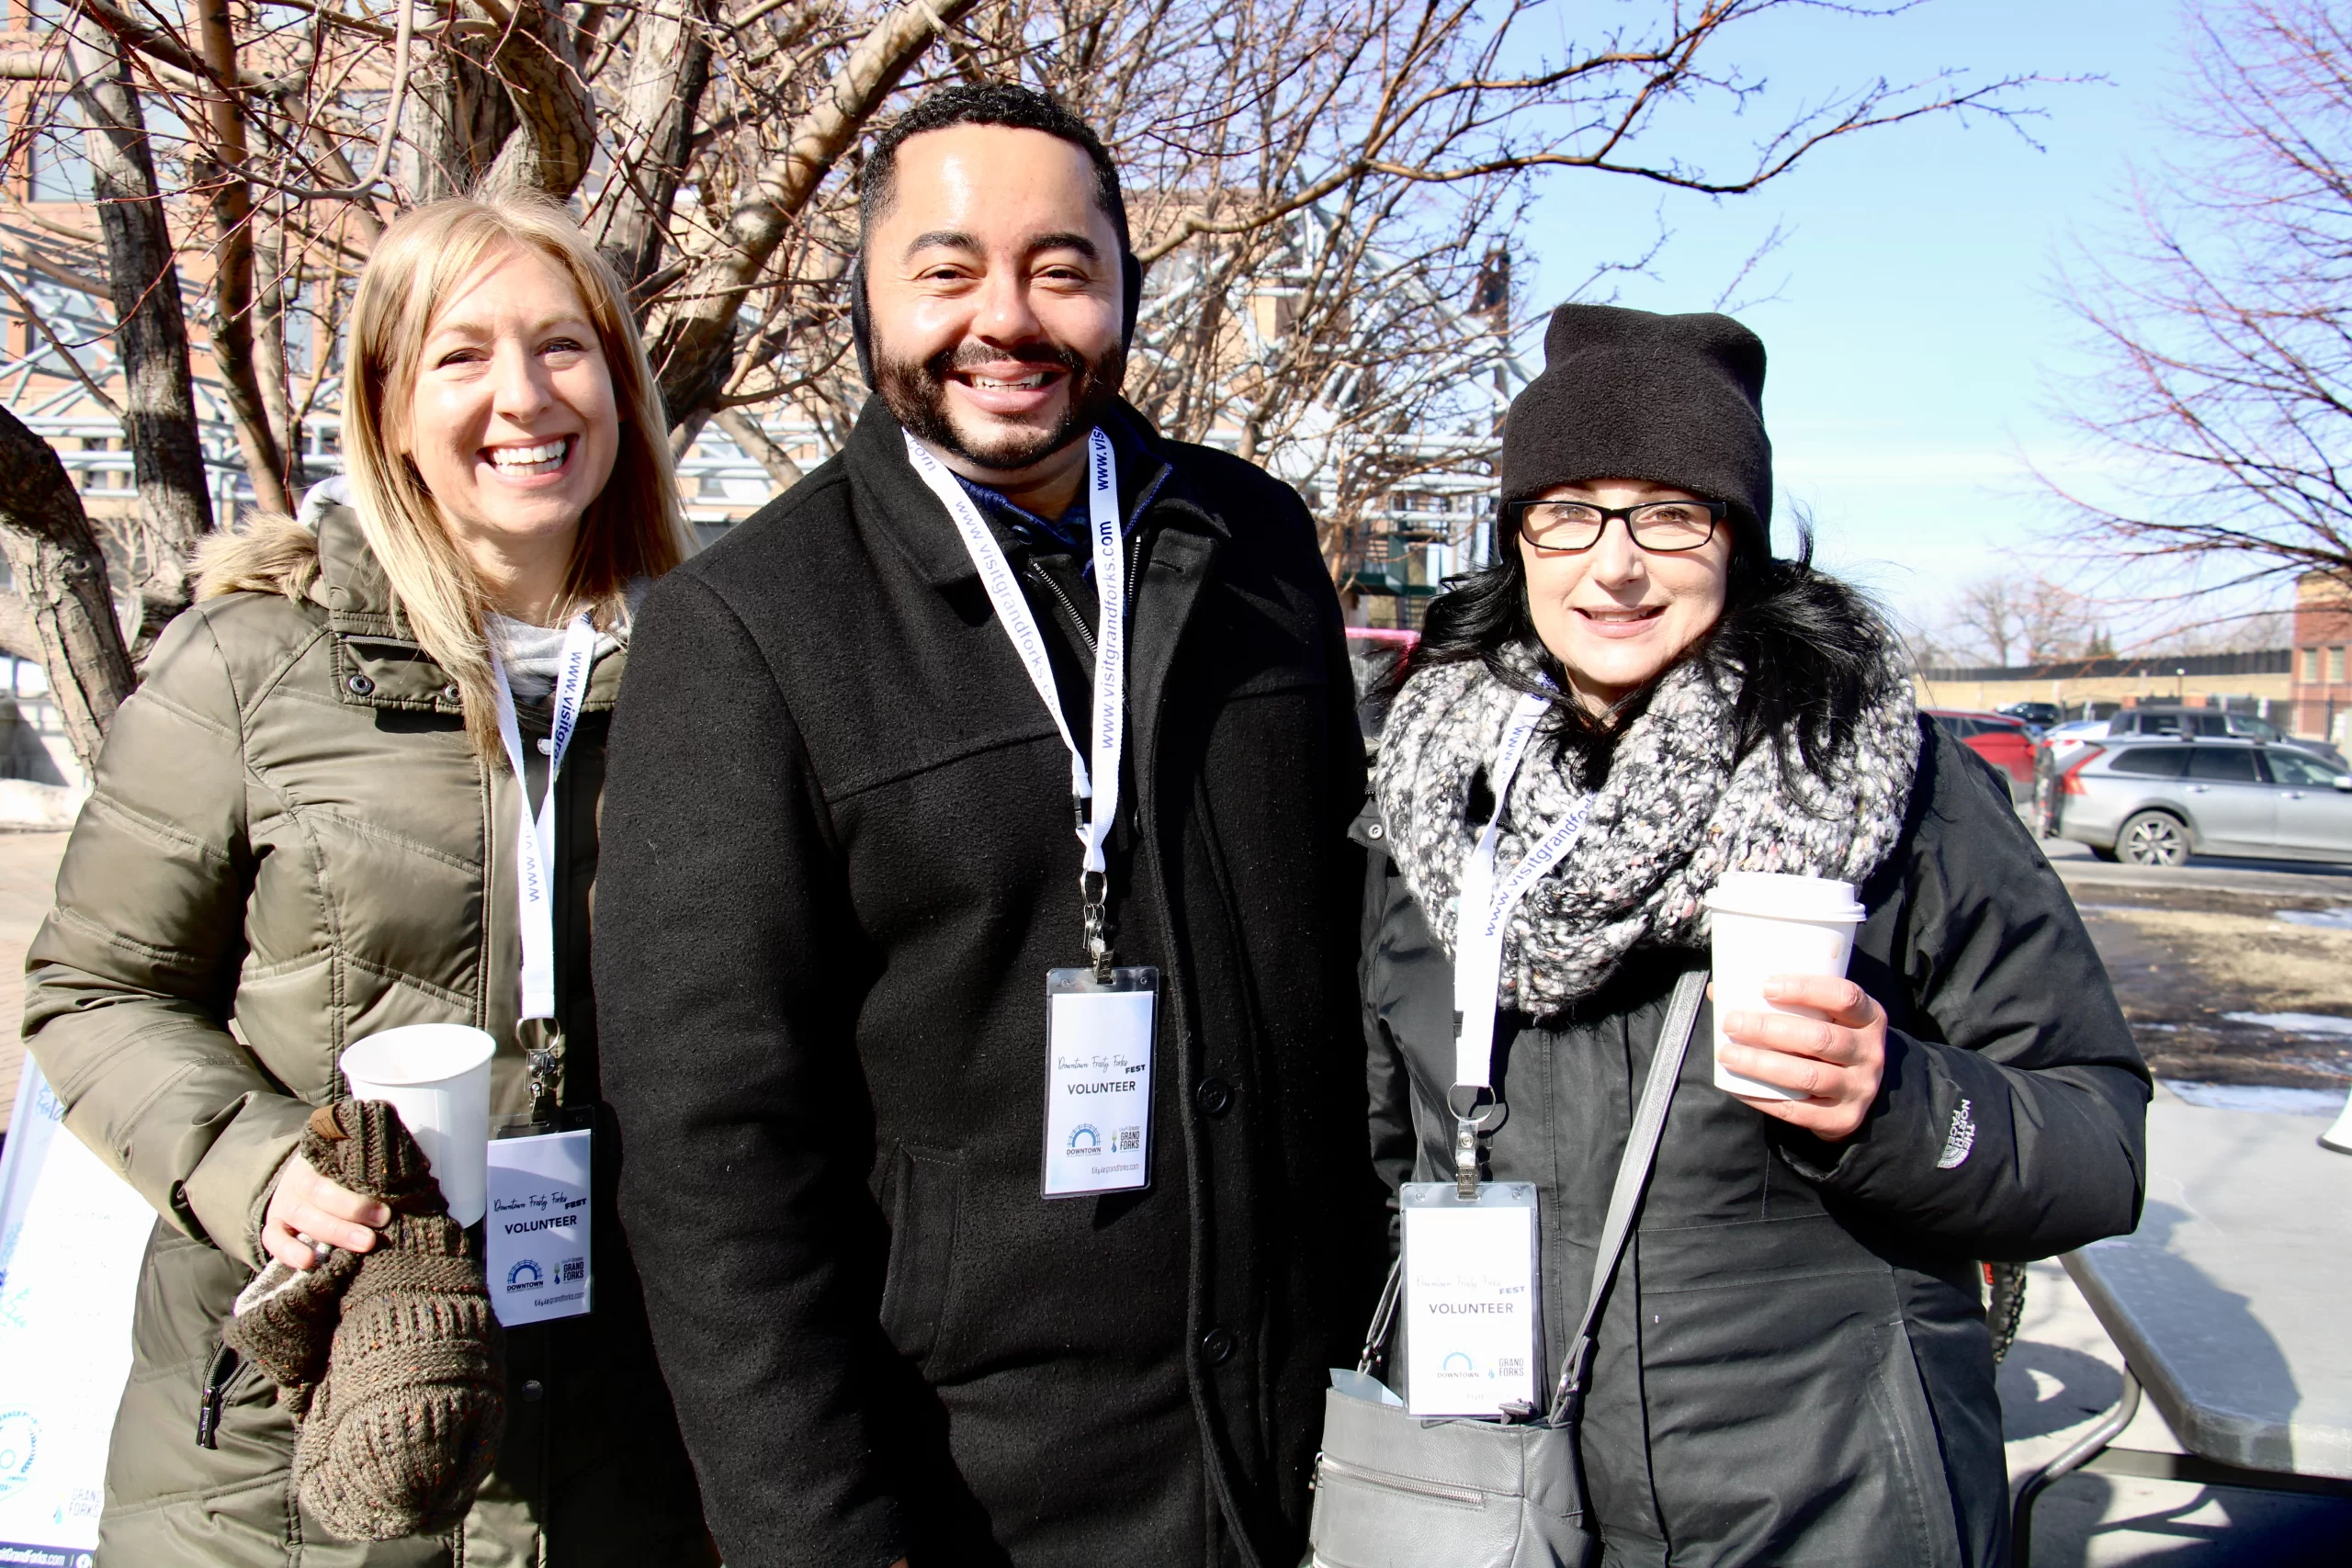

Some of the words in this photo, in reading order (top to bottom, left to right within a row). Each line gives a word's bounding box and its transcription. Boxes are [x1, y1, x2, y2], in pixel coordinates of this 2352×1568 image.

[1100, 521, 1118, 750] www.visitgrandforks.com
[553, 651, 582, 770] www.visitgra
[1057, 1056, 1089, 1069] Downtown
[1091, 1055, 1110, 1073] Frosty
[1113, 1055, 1128, 1066] Forks
[1125, 1064, 1146, 1074] FEST
[1068, 1081, 1136, 1095] VOLUNTEER
[1948, 1110, 1962, 1145] FACE
[1954, 1099, 1971, 1148] NORTH
[1120, 1131, 1139, 1141] GRAND
[1962, 1123, 1975, 1150] THE
[1120, 1140, 1139, 1150] FORKS
[493, 1197, 526, 1213] Downtown
[529, 1194, 548, 1211] Frosty
[551, 1191, 568, 1203] Forks
[564, 1198, 587, 1210] FEST
[504, 1214, 578, 1235] VOLUNTEER
[563, 1261, 584, 1273] GRAND
[563, 1270, 584, 1281] FORKS
[506, 1280, 544, 1292] DOWNTOWN
[1499, 1286, 1525, 1295] FEST
[1429, 1303, 1514, 1314] VOLUNTEER
[1498, 1358, 1524, 1368] GRAND
[1498, 1367, 1524, 1377] FORKS
[71, 1488, 103, 1503] GRAND
[68, 1502, 100, 1517] FORKS
